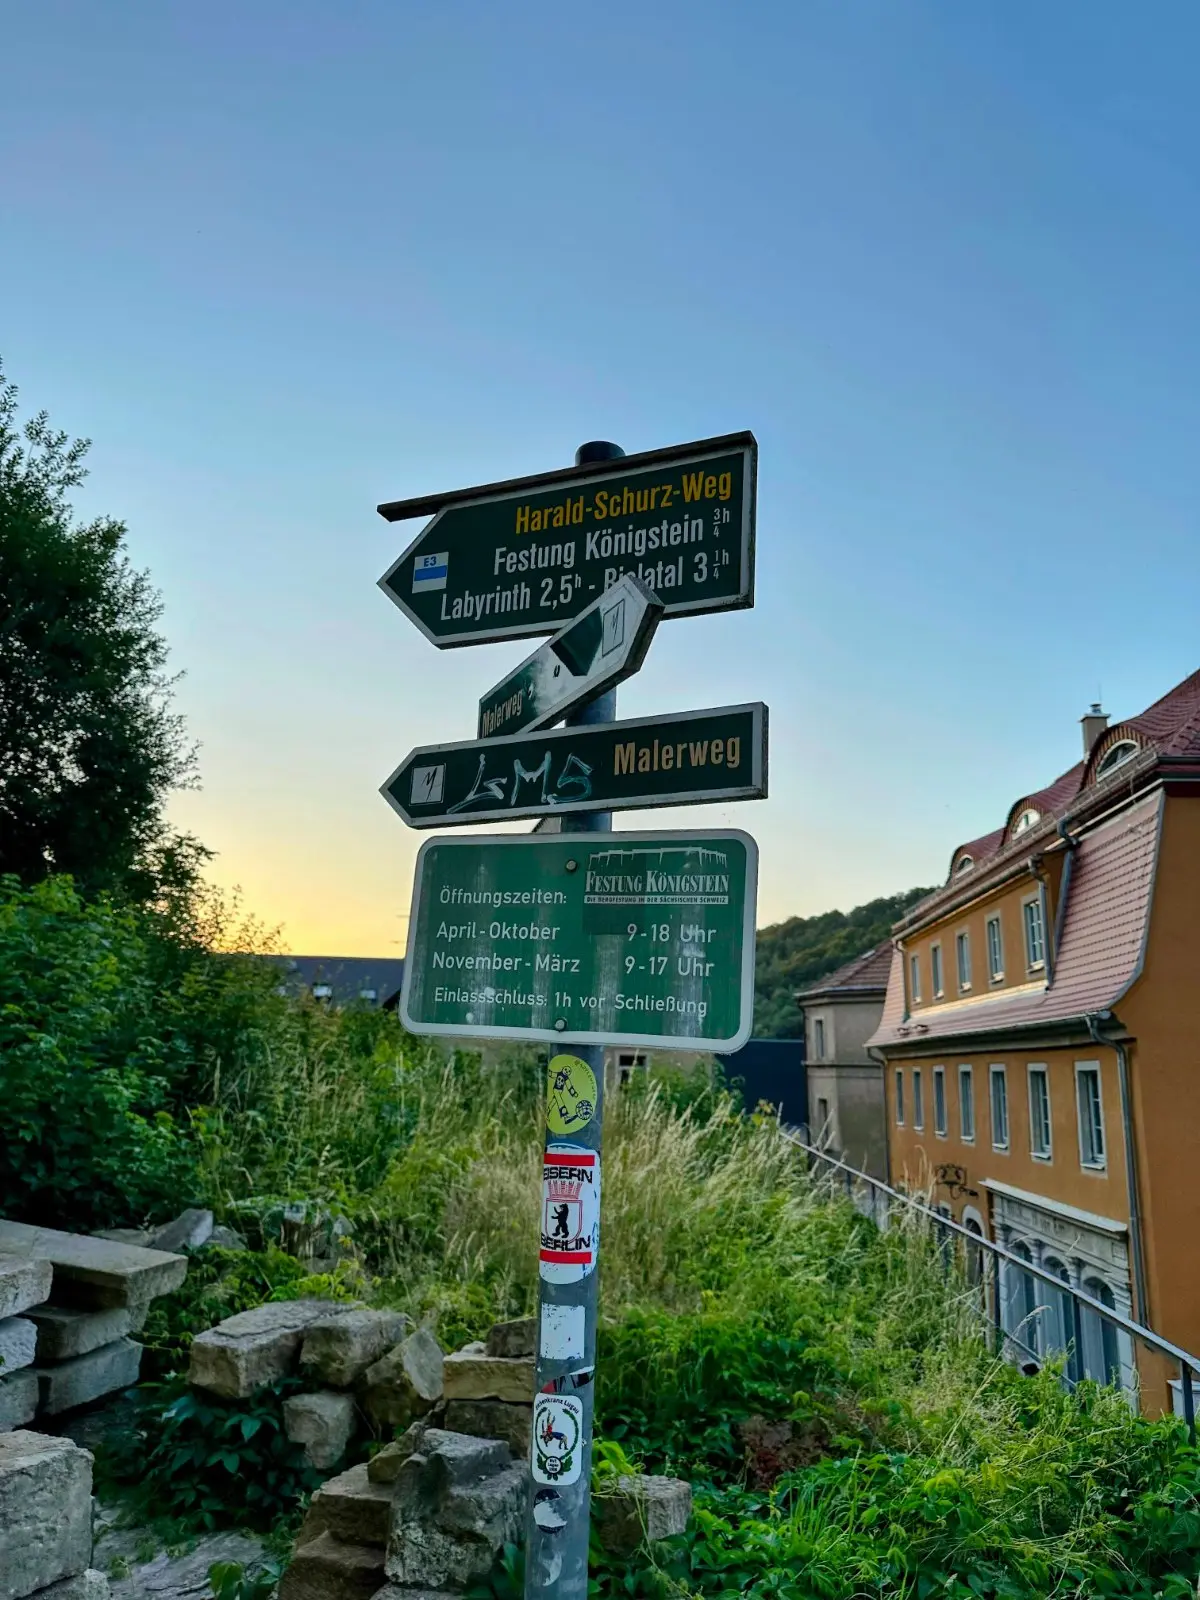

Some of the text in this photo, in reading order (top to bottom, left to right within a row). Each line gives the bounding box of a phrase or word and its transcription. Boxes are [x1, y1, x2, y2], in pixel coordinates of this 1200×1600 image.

[515, 471, 732, 535] Harald-Schurz-Weg
[423, 556, 437, 568] E3
[493, 541, 576, 576] Festung
[585, 514, 704, 561] Königstein
[440, 581, 532, 622] Labyrinth
[481, 688, 523, 740] Malerweg
[613, 735, 741, 776] Malerweg
[439, 884, 567, 908] Öffnungszeiten:
[679, 925, 717, 944] Uhr
[677, 956, 715, 977] Uhr
[434, 986, 548, 1007] Einlassschluss:
[579, 995, 605, 1009] vor
[614, 993, 708, 1018] Schließung
